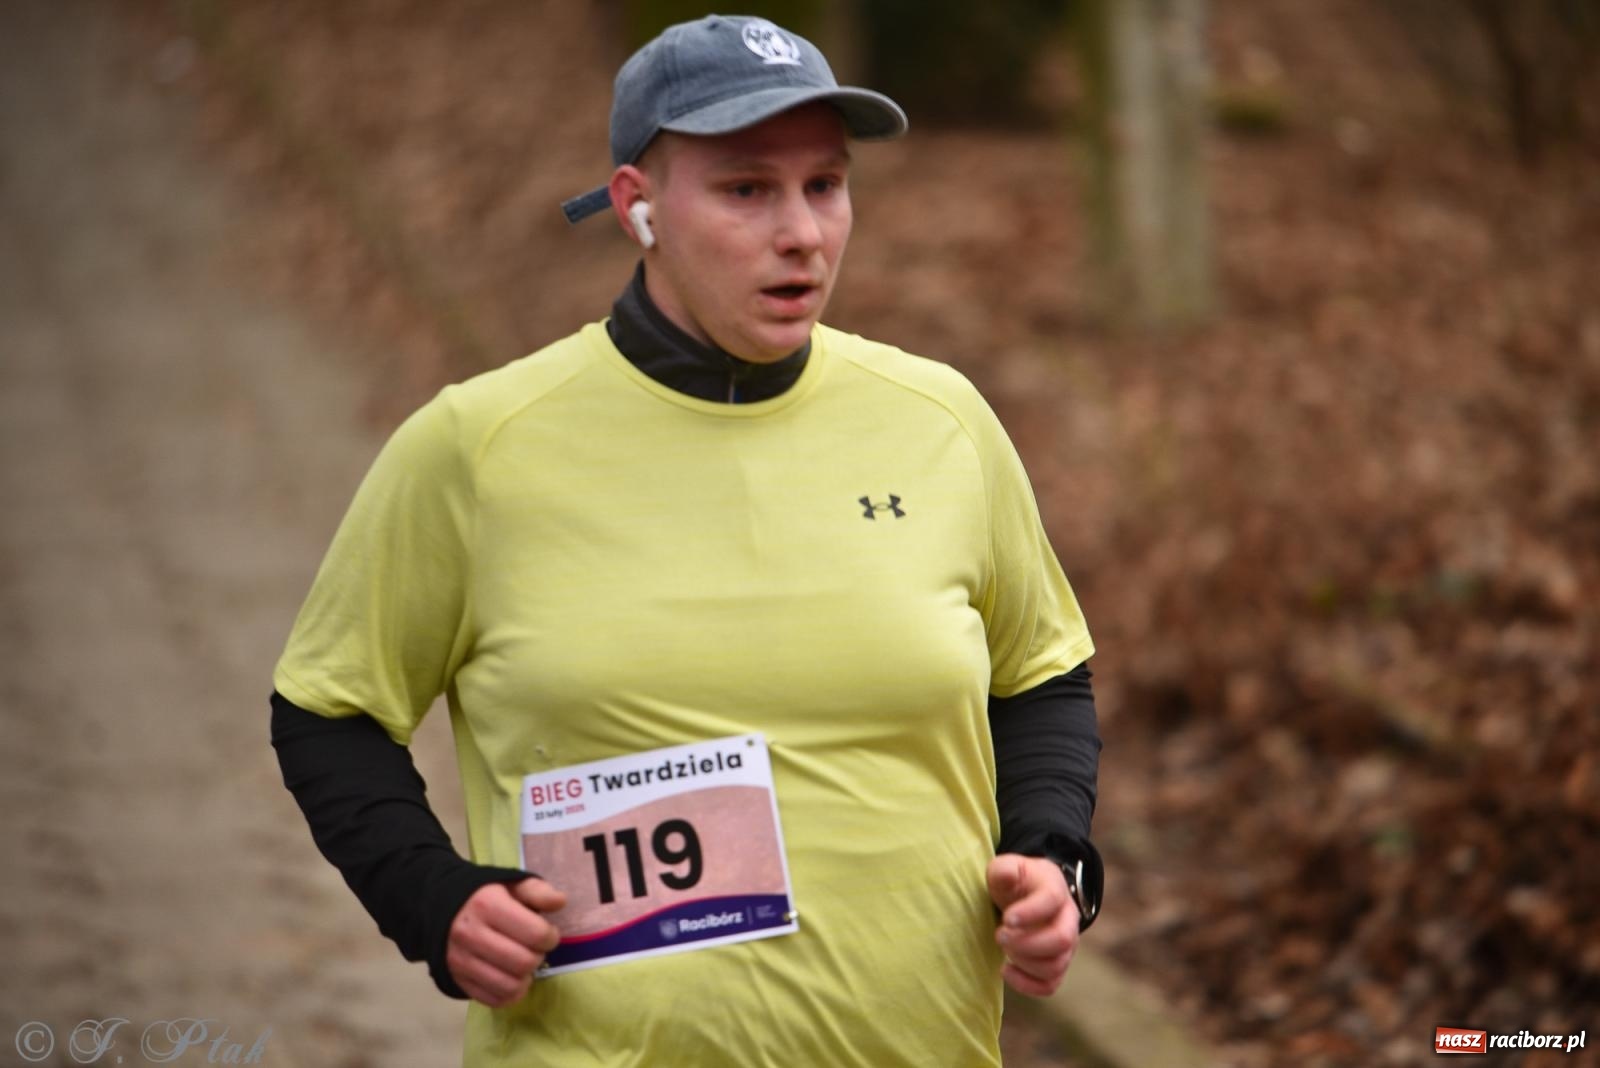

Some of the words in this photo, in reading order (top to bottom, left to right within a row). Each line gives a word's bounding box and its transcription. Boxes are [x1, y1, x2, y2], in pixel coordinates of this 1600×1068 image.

[530, 778, 583, 806] BIEG
[588, 751, 743, 794] Twardziela
[583, 818, 703, 905] 119
